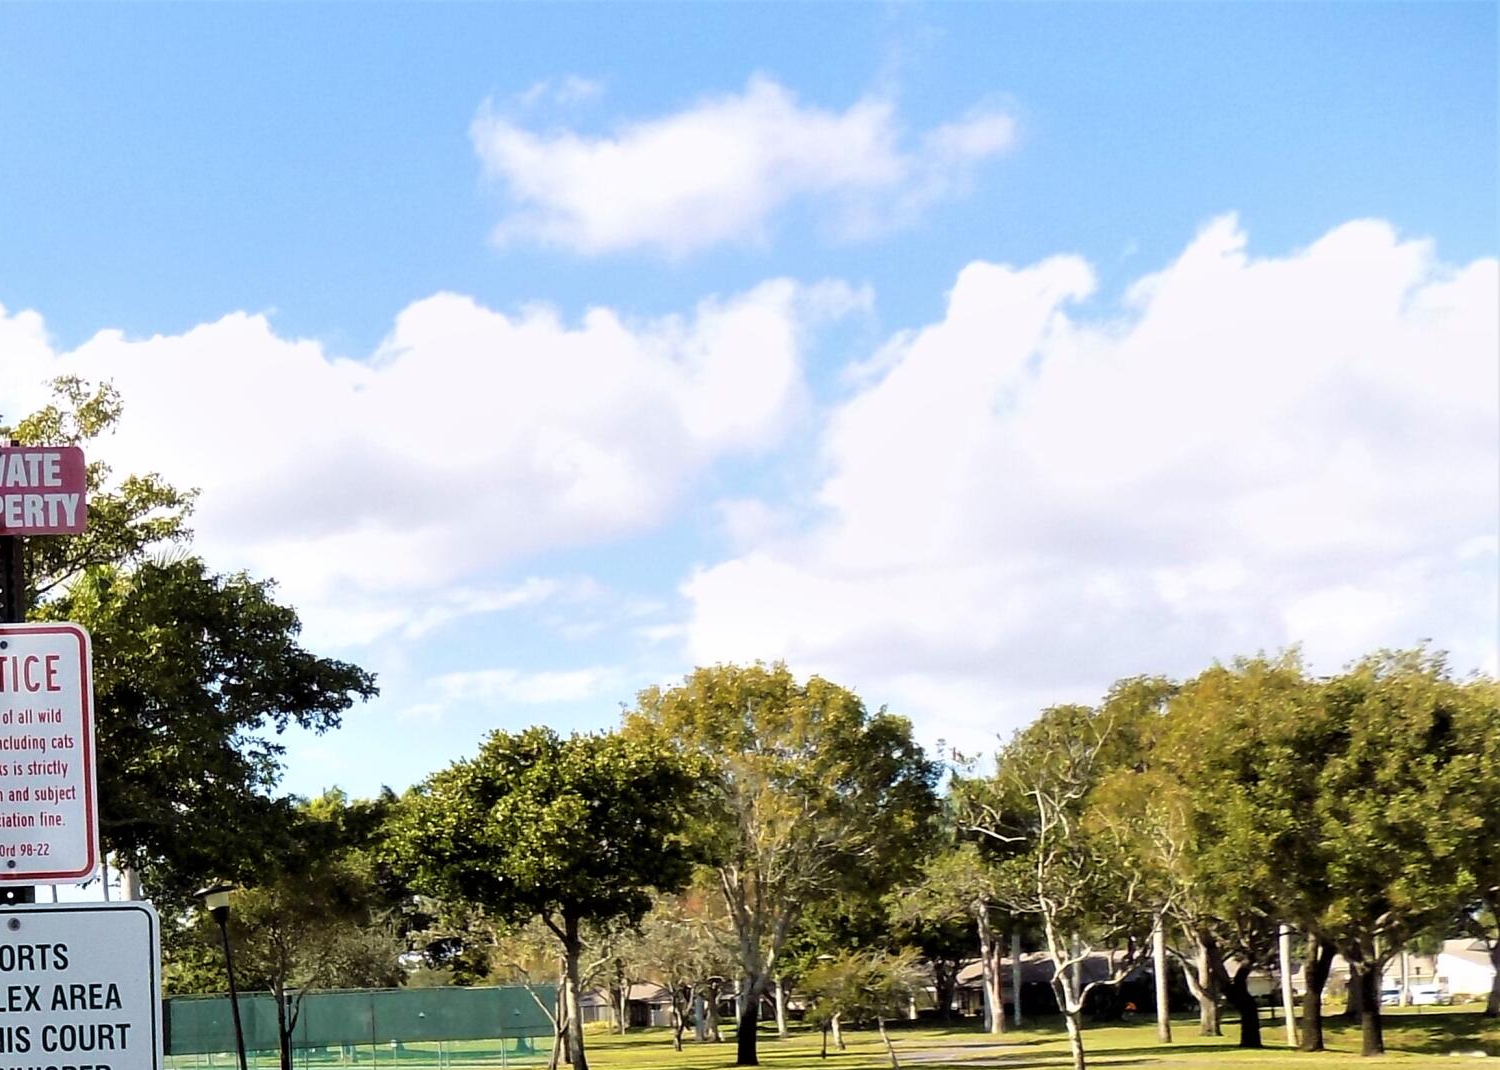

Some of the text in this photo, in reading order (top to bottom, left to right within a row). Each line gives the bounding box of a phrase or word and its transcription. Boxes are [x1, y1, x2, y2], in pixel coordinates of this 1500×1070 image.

[3, 709, 13, 724] of
[18, 709, 33, 724] all
[38, 708, 62, 723] wild
[51, 734, 74, 749] cats
[13, 761, 23, 775] is
[28, 760, 68, 778] strictly
[8, 787, 29, 801] and
[34, 785, 76, 805] subject
[40, 812, 66, 826] fine.
[0, 844, 16, 857] Ord
[20, 843, 50, 856] 98-22
[50, 983, 122, 1011] AREA
[42, 1023, 131, 1051] COURT
